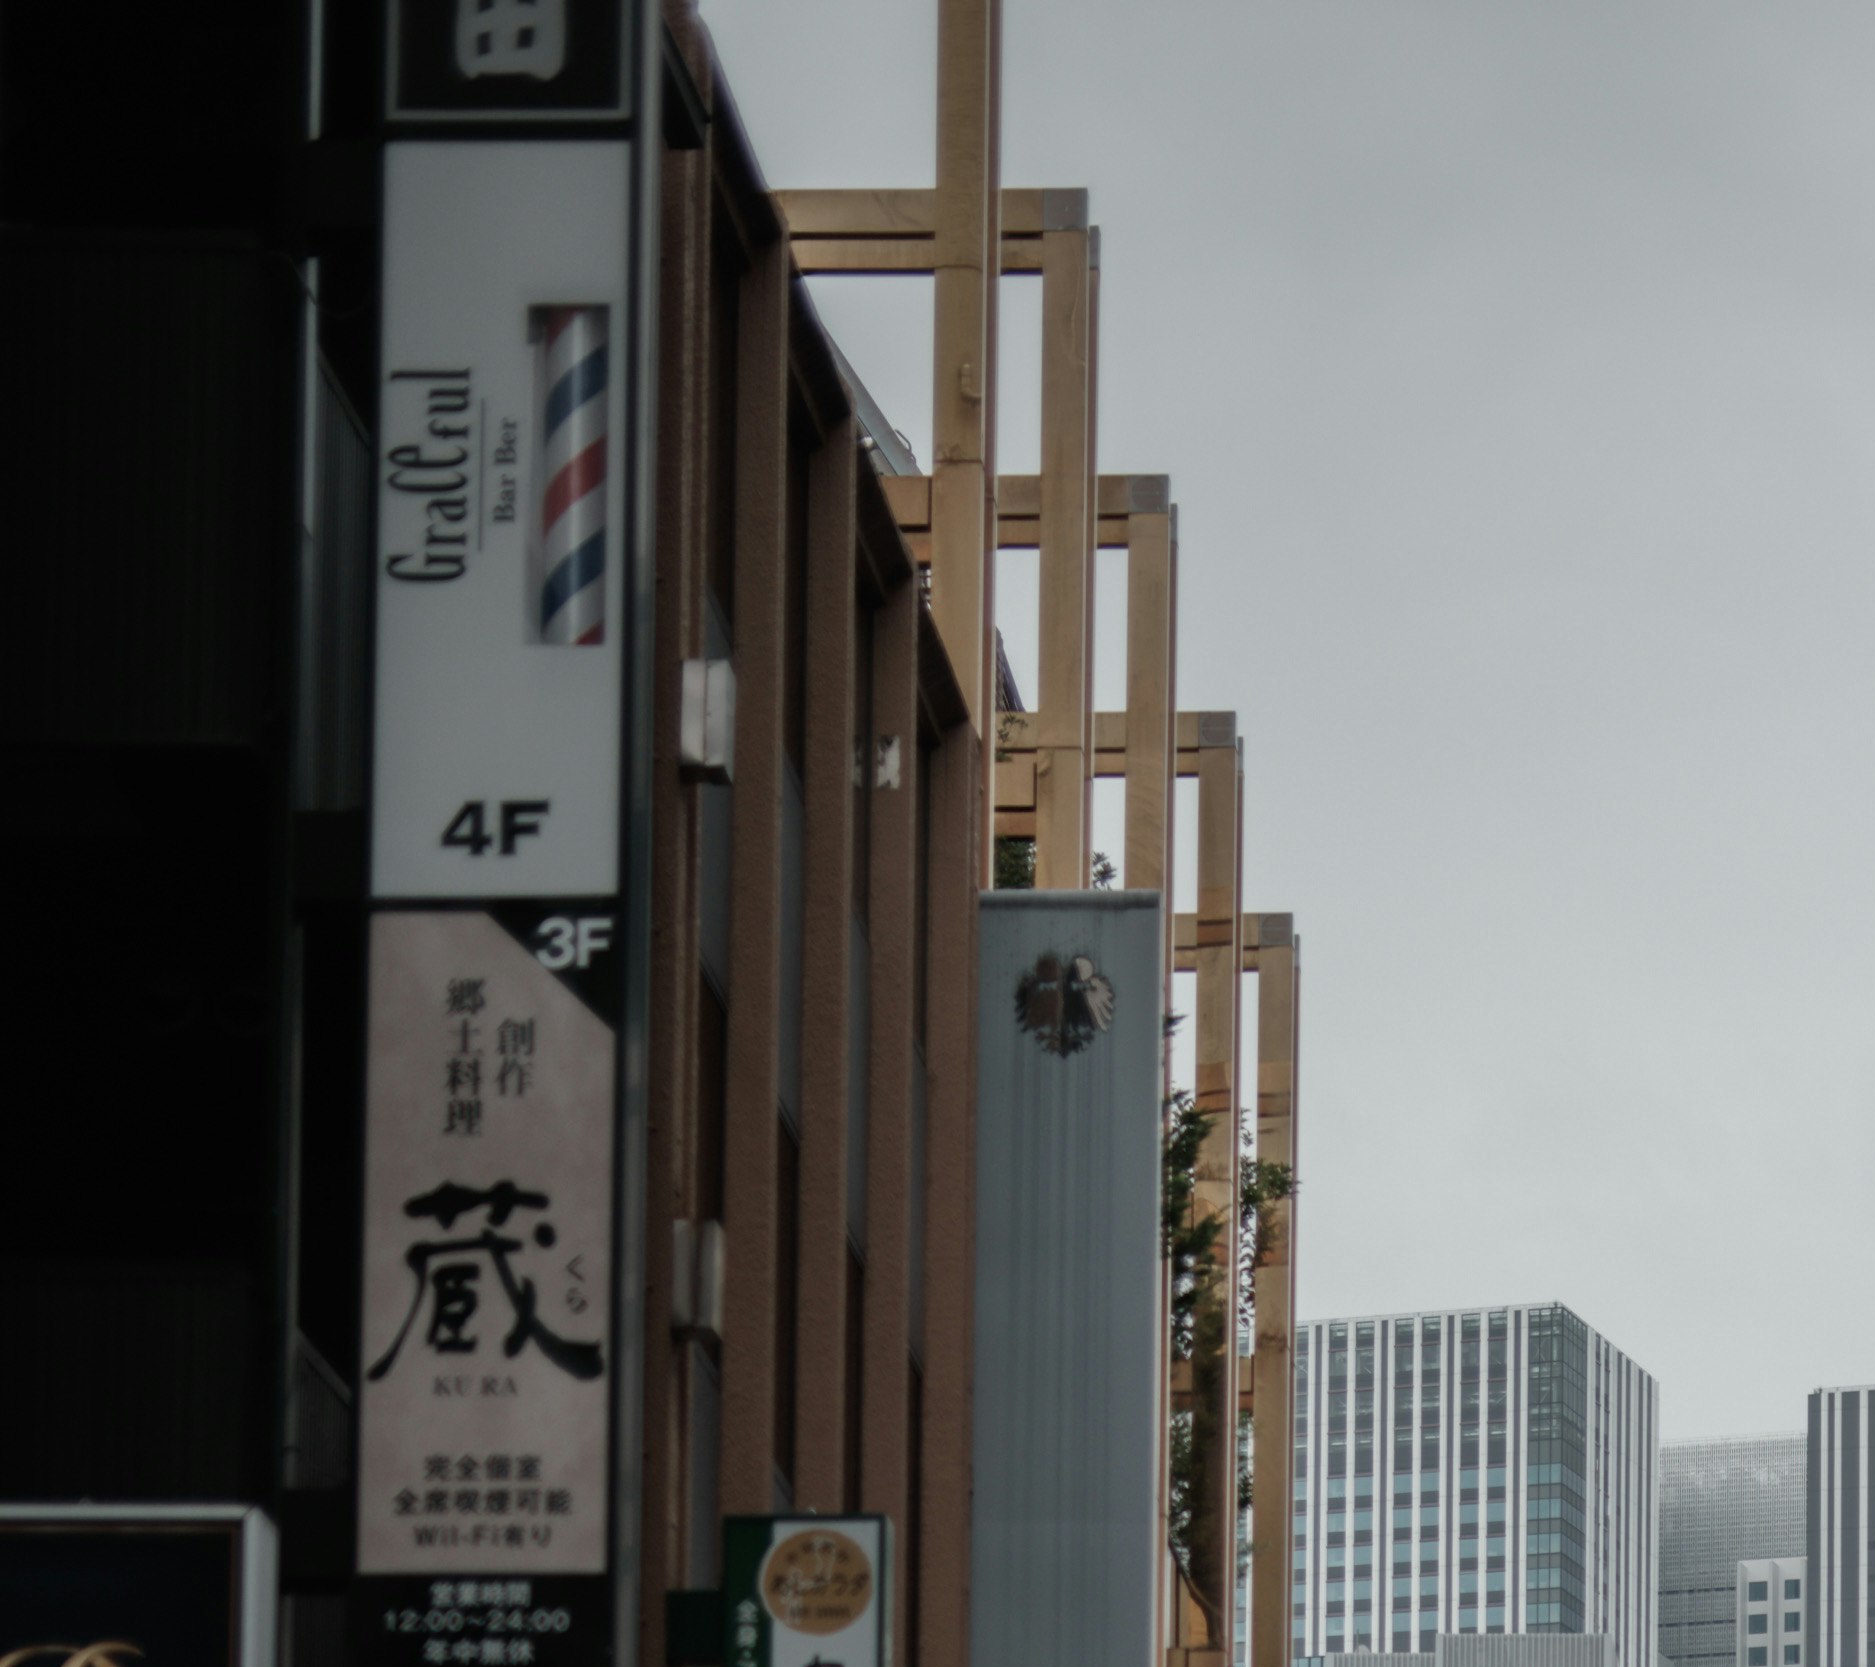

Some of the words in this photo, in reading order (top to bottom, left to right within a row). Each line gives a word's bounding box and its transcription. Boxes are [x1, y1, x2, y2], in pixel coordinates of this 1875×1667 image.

[494, 417, 518, 465] Ber
[493, 474, 517, 522] Bar
[441, 801, 549, 857] 4F
[536, 915, 615, 971] 3F
[445, 977, 486, 1136] 郷土料理
[497, 1017, 536, 1097] 創作
[367, 1179, 604, 1382] 蔵
[565, 1254, 589, 1315] くら
